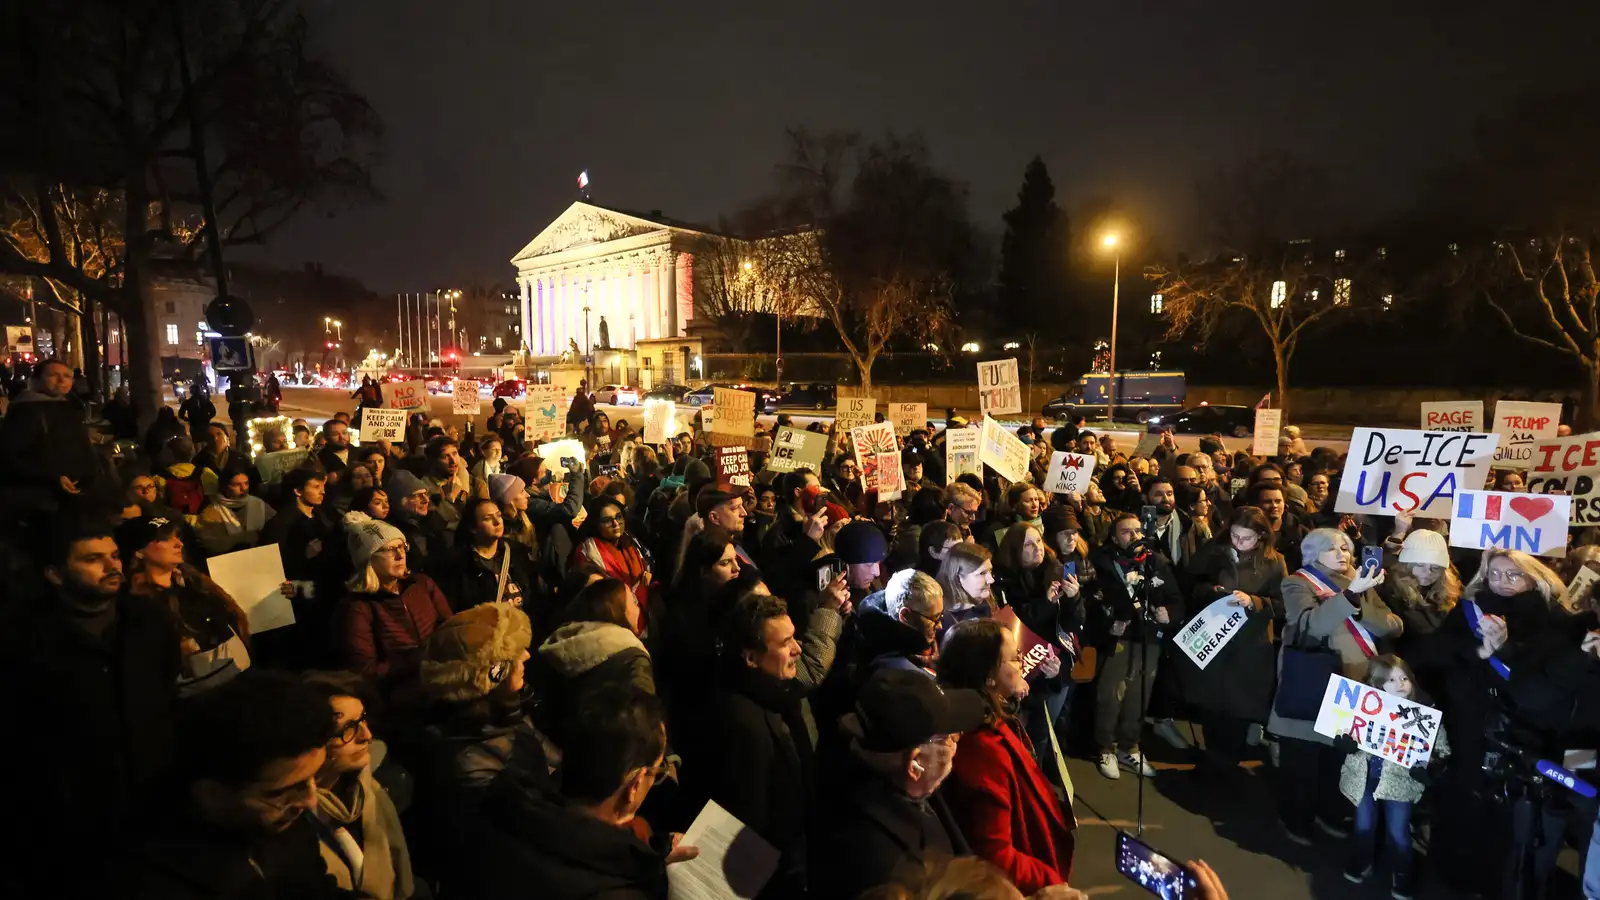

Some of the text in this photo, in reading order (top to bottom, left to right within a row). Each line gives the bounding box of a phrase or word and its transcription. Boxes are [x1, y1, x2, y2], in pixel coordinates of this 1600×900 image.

[981, 361, 1018, 386] FUCK
[395, 387, 415, 398] NO
[980, 387, 1017, 410] TRUMP
[391, 396, 428, 409] KINGS!
[850, 399, 864, 411] US
[900, 404, 917, 412] FIGHT
[838, 411, 859, 419] NEEDS
[1427, 411, 1474, 426] RAGE
[727, 420, 741, 429] OF
[837, 419, 851, 430] ICE
[1503, 416, 1551, 431] TRUMP
[1521, 432, 1535, 441] LA
[775, 446, 795, 459] ICE
[1362, 431, 1488, 468] De-ICE
[721, 455, 737, 466] KEEP
[1533, 440, 1600, 473] ICE
[723, 465, 739, 475] AND
[771, 457, 816, 470] BREAKER
[1060, 471, 1077, 481] NO
[1055, 482, 1077, 491] KINGS
[1355, 470, 1457, 512] USA
[1480, 522, 1542, 553] MN
[1189, 630, 1212, 655] ICE
[1196, 611, 1243, 662] BREAKER
[1333, 678, 1383, 715] NO
[1331, 708, 1430, 766] TRUMP
[1545, 768, 1564, 781] AFP
